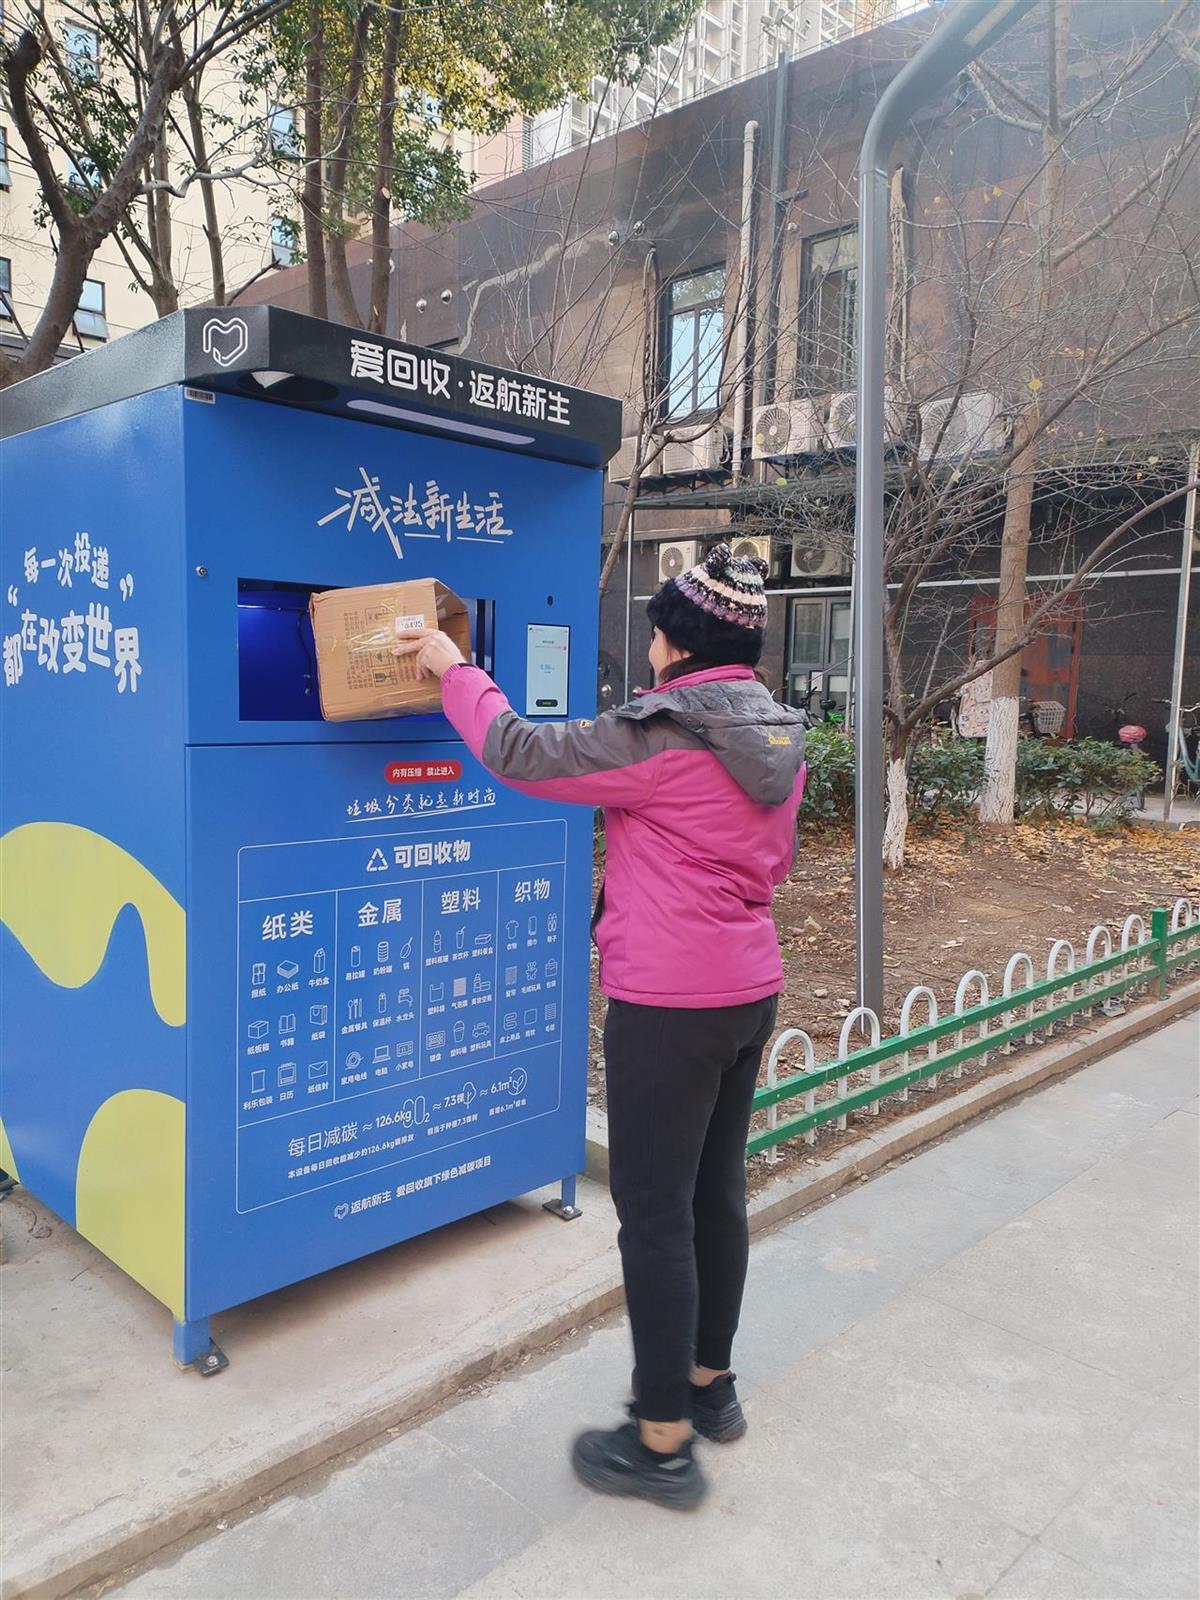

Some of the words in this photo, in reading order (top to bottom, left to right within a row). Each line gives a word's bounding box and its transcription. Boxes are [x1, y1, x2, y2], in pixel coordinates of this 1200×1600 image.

[349, 338, 571, 426] 爱回收·返航新生
[317, 467, 513, 560] 减法新生活
[392, 767, 422, 778] 内有压缩
[426, 766, 454, 776] 禁止进入
[346, 787, 496, 816] 垃圾分类就是新时尚
[393, 839, 471, 869] 可回收物
[441, 887, 480, 915] 塑料
[514, 878, 550, 902] 织物
[262, 910, 313, 940] 纸类
[358, 898, 402, 927] 金属
[276, 982, 299, 993] 办公纸
[308, 977, 330, 987] 牛奶盒
[280, 1090, 295, 1101] 日历
[288, 1121, 358, 1157] 每日减碳
[350, 1190, 392, 1214] 返航新生
